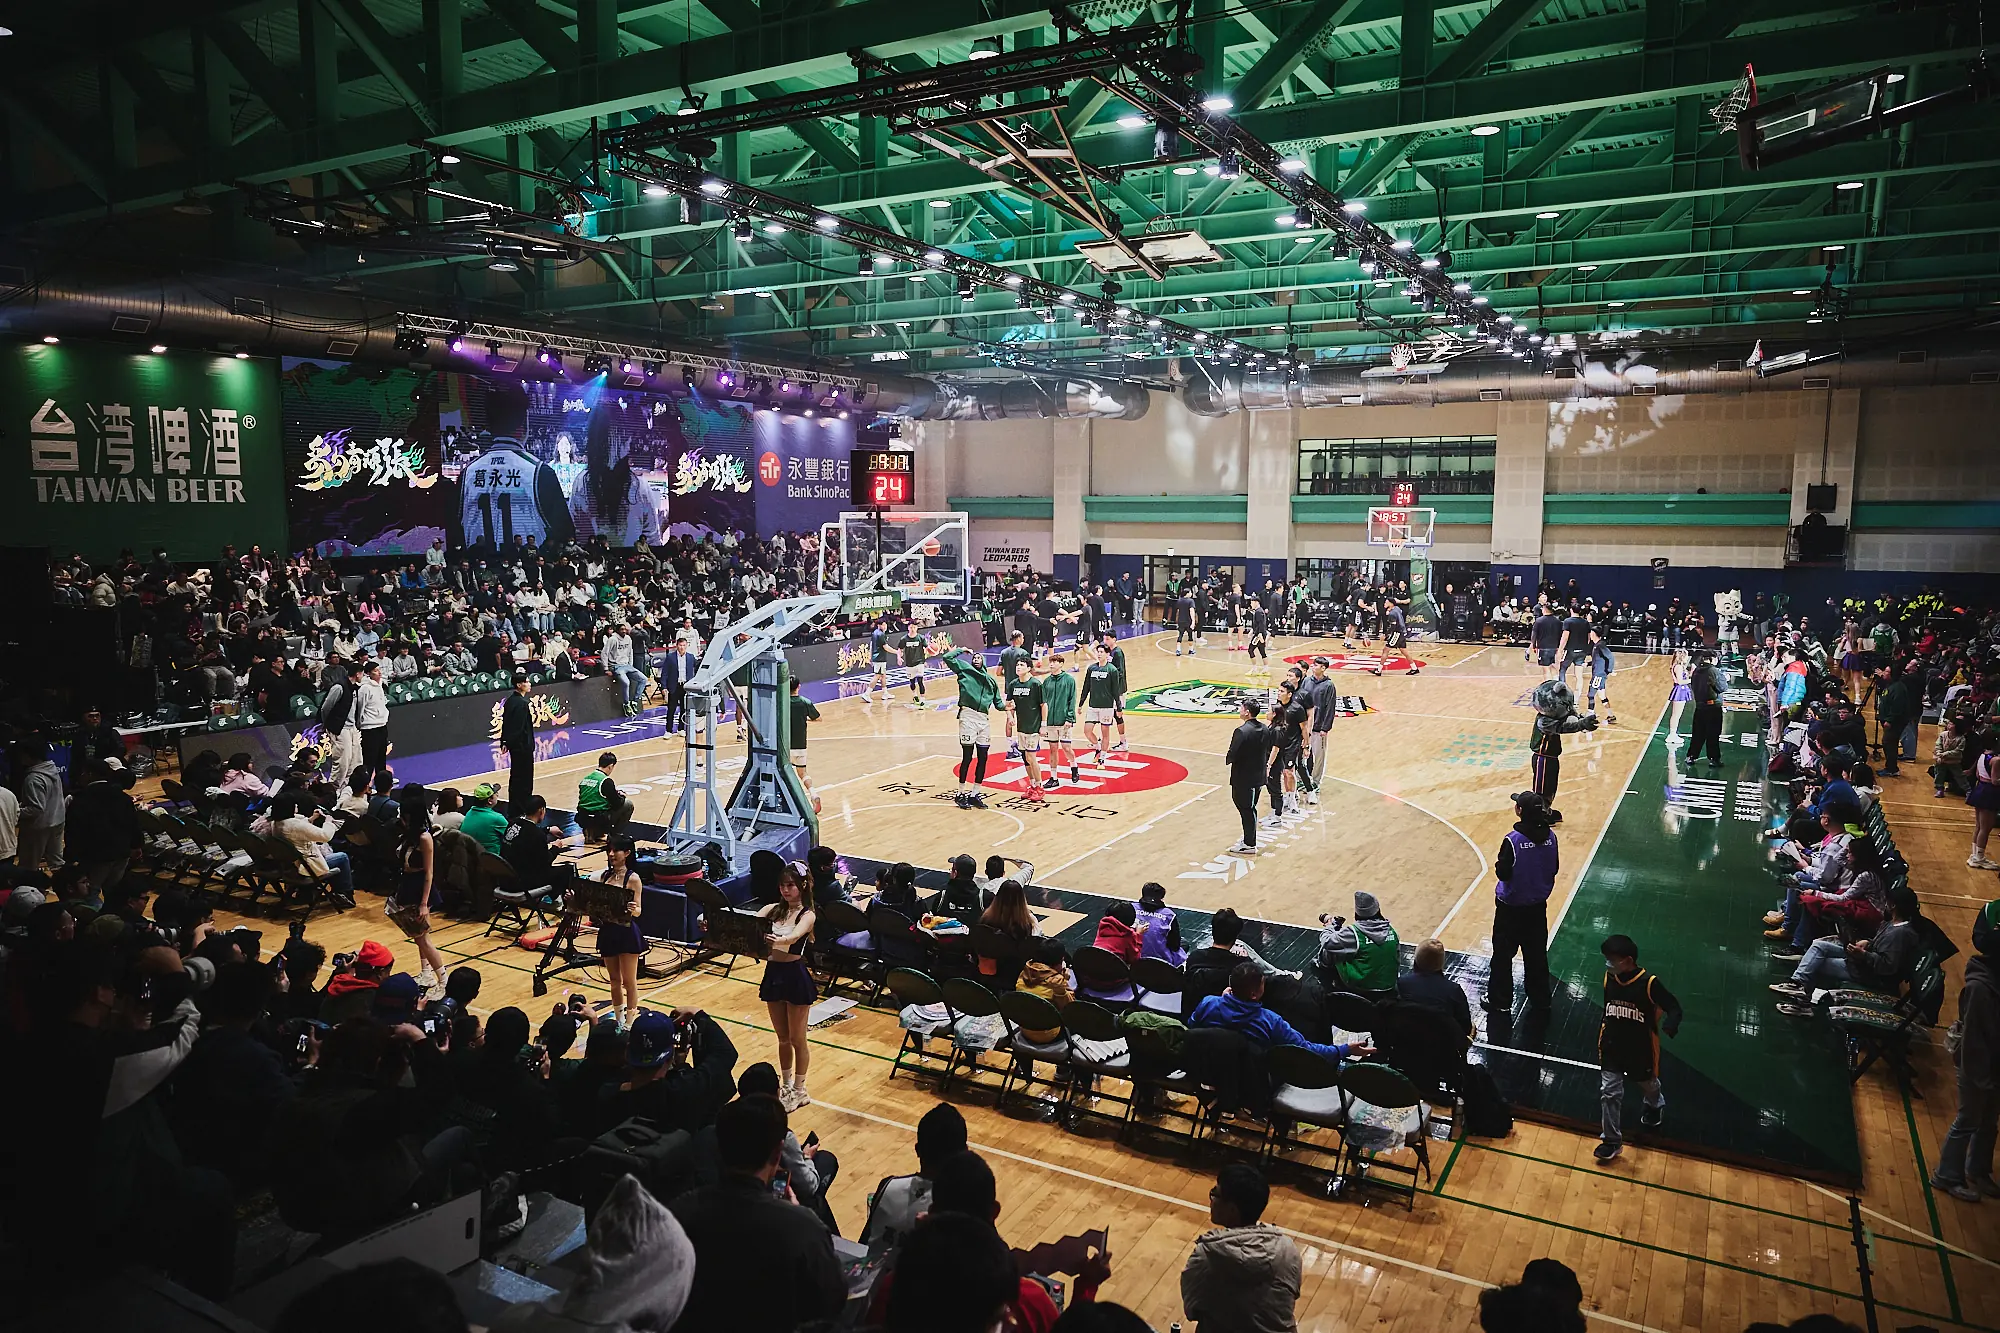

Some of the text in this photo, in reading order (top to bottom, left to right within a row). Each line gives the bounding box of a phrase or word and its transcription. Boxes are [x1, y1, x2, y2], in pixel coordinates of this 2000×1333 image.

[31, 399, 241, 475] 台湾啤酒
[473, 469, 521, 488] 葛永光
[788, 456, 849, 482] 永豐銀行
[30, 477, 246, 503] TAIWAN BEER
[788, 485, 850, 499] Bank SinoPac
[875, 476, 902, 500] 24
[1396, 493, 1411, 504] 24
[477, 492, 513, 550] 11
[983, 554, 1030, 562] LEOPARDS
[1135, 909, 1167, 921] EOPARDS
[1605, 1002, 1645, 1023] Leopards
